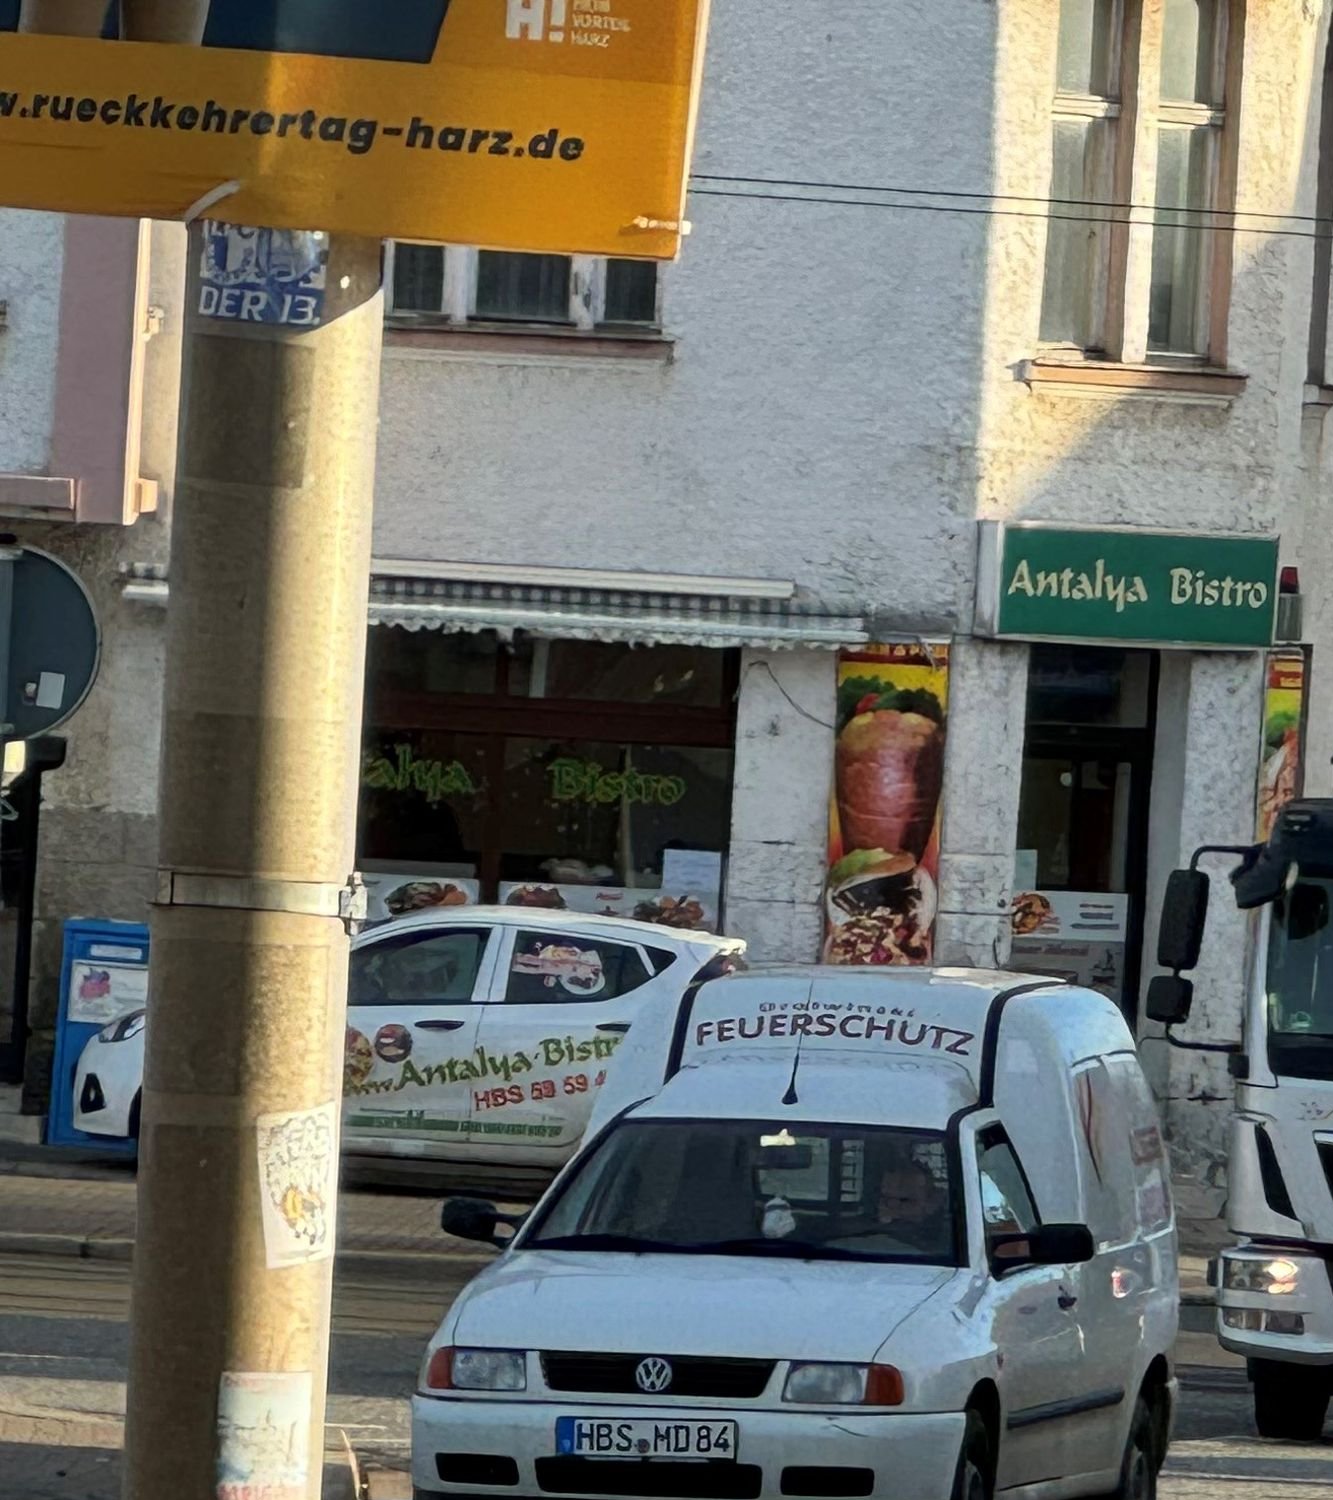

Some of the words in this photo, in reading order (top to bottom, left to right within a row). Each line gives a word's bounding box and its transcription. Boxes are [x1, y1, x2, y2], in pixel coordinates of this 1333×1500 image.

[199, 285, 268, 321] DER
[1007, 559, 1148, 612] Antalya
[1170, 567, 1268, 609] Bistro
[547, 757, 686, 805] Bistro
[696, 1012, 975, 1056] FEUERSCHUTZ
[575, 1423, 633, 1451] HBS
[653, 1424, 690, 1452] MD
[696, 1425, 730, 1453] 84
